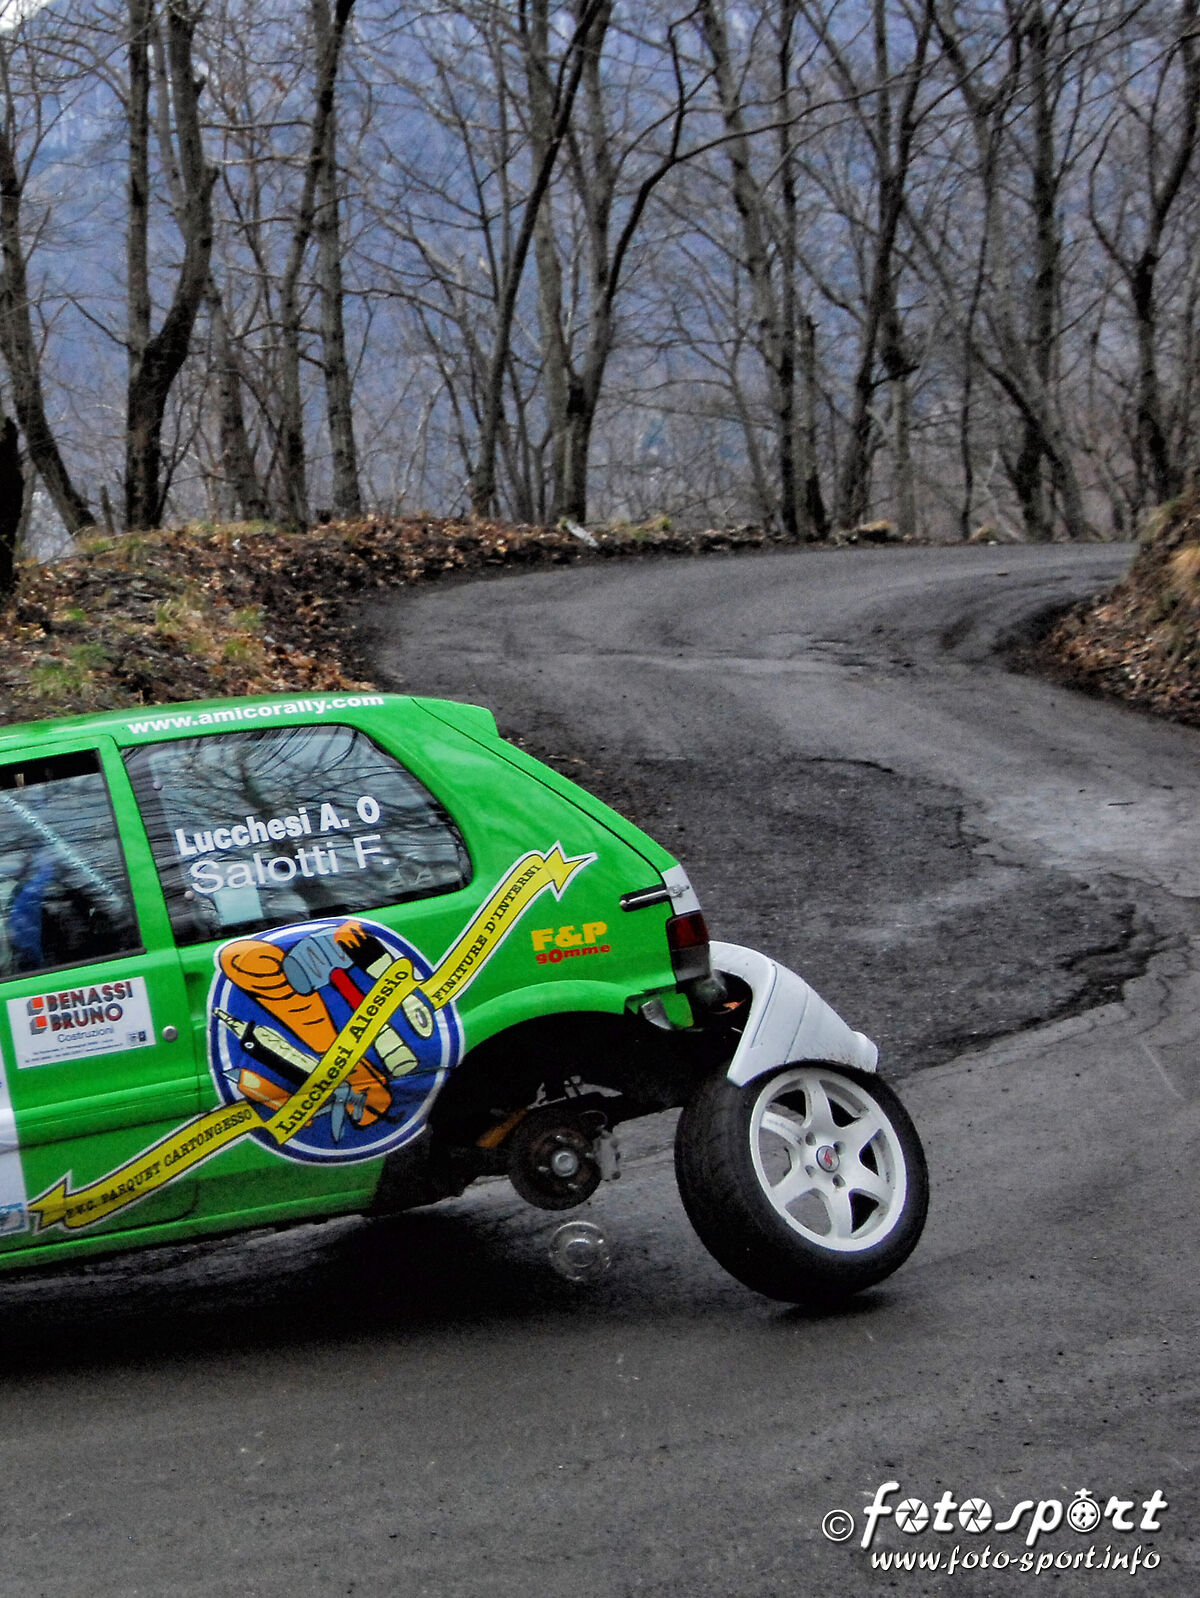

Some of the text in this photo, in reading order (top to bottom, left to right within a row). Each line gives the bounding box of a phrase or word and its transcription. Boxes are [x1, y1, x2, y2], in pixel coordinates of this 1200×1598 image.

[127, 696, 385, 734] www.amicorally.com
[175, 807, 312, 856] Lucchesi
[320, 803, 350, 830] A.
[189, 834, 390, 894] Salotti F.
[431, 864, 542, 1002] FINITURE D'INTERNI
[531, 921, 608, 951] F&P
[46, 981, 133, 1012] BENASSI
[50, 1003, 123, 1031] BRUNO
[57, 1027, 115, 1043] Costruzioni
[275, 968, 409, 1134] Lucchesi Alessio
[101, 1162, 161, 1205] PARQUET
[164, 1108, 253, 1166] CARTONGESSO
